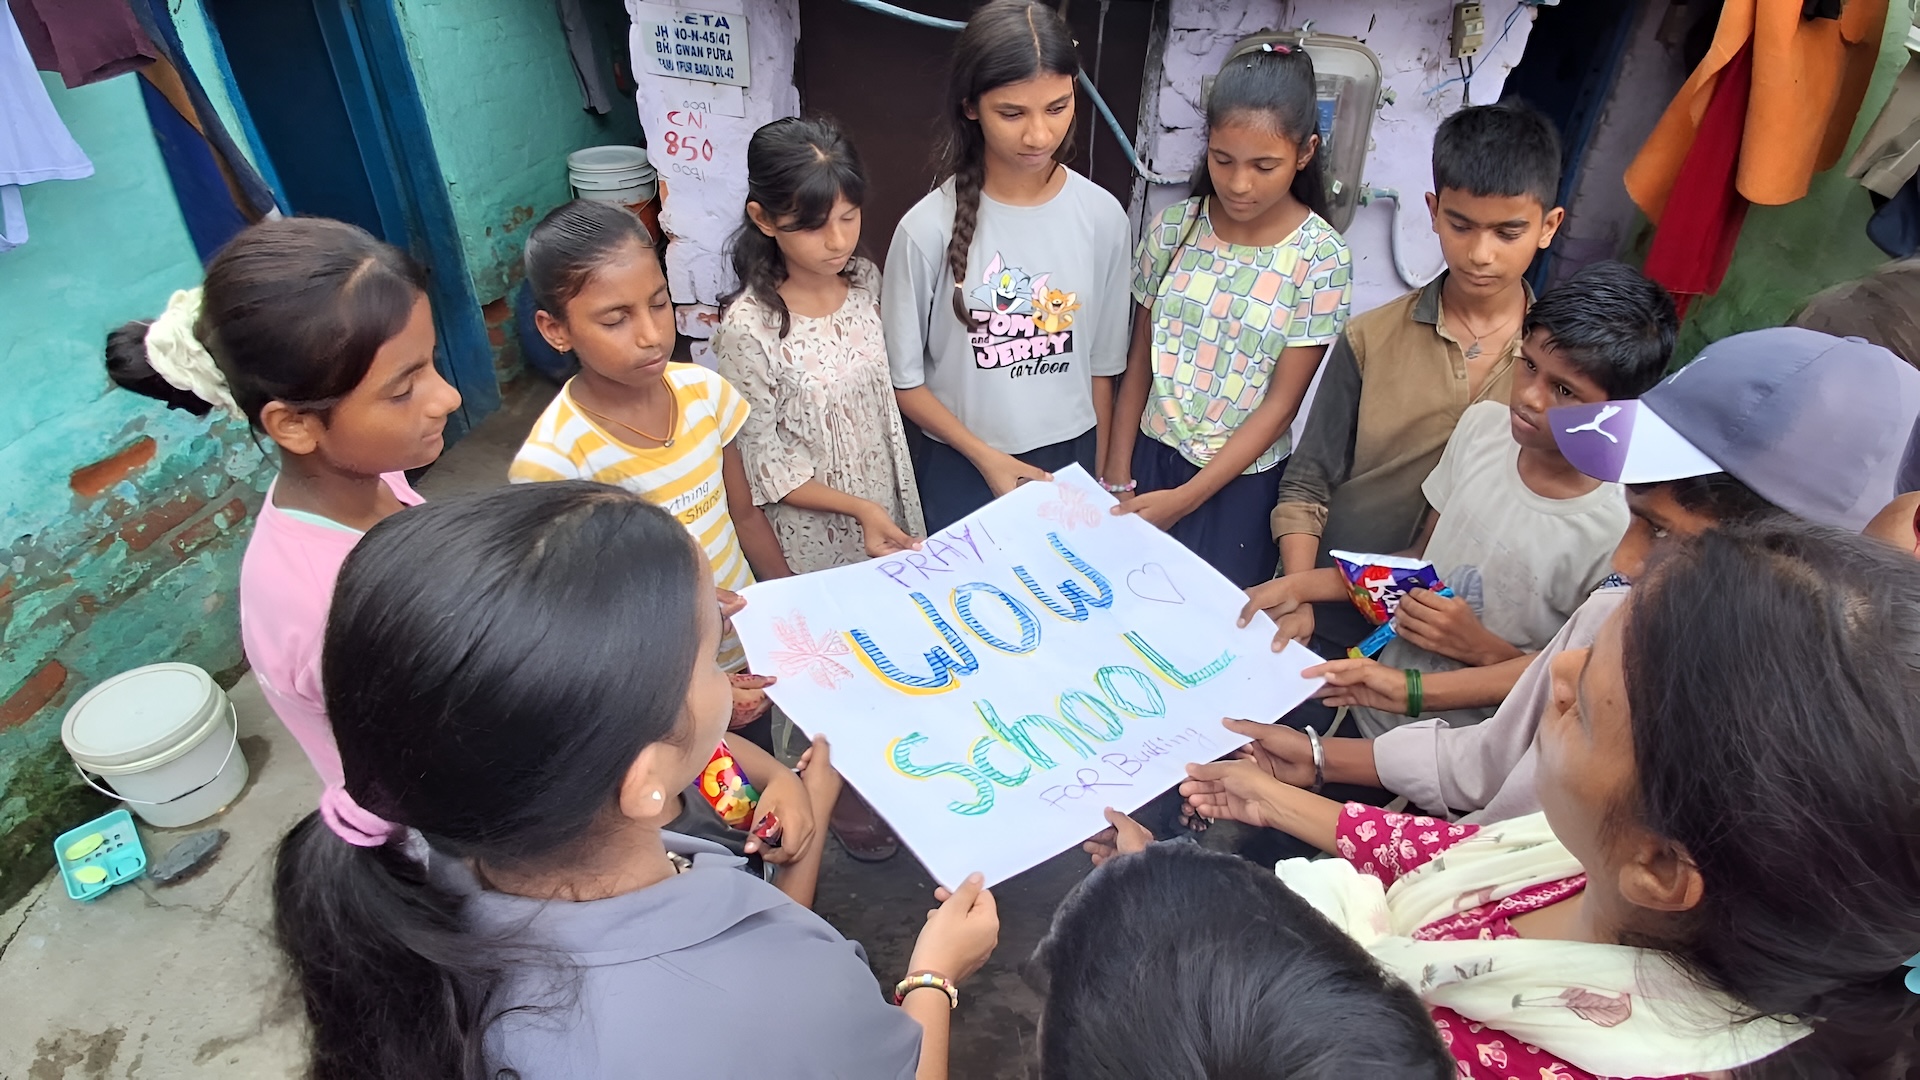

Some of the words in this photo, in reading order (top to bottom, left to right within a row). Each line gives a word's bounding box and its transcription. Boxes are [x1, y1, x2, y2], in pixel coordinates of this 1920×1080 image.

[707, 47, 734, 62] PURA
[664, 131, 713, 161] 850
[970, 309, 1036, 337] TOM
[970, 335, 990, 345] and
[976, 332, 1071, 369] JERRY
[1010, 357, 1070, 379] cartoon
[841, 531, 1114, 696] WOW
